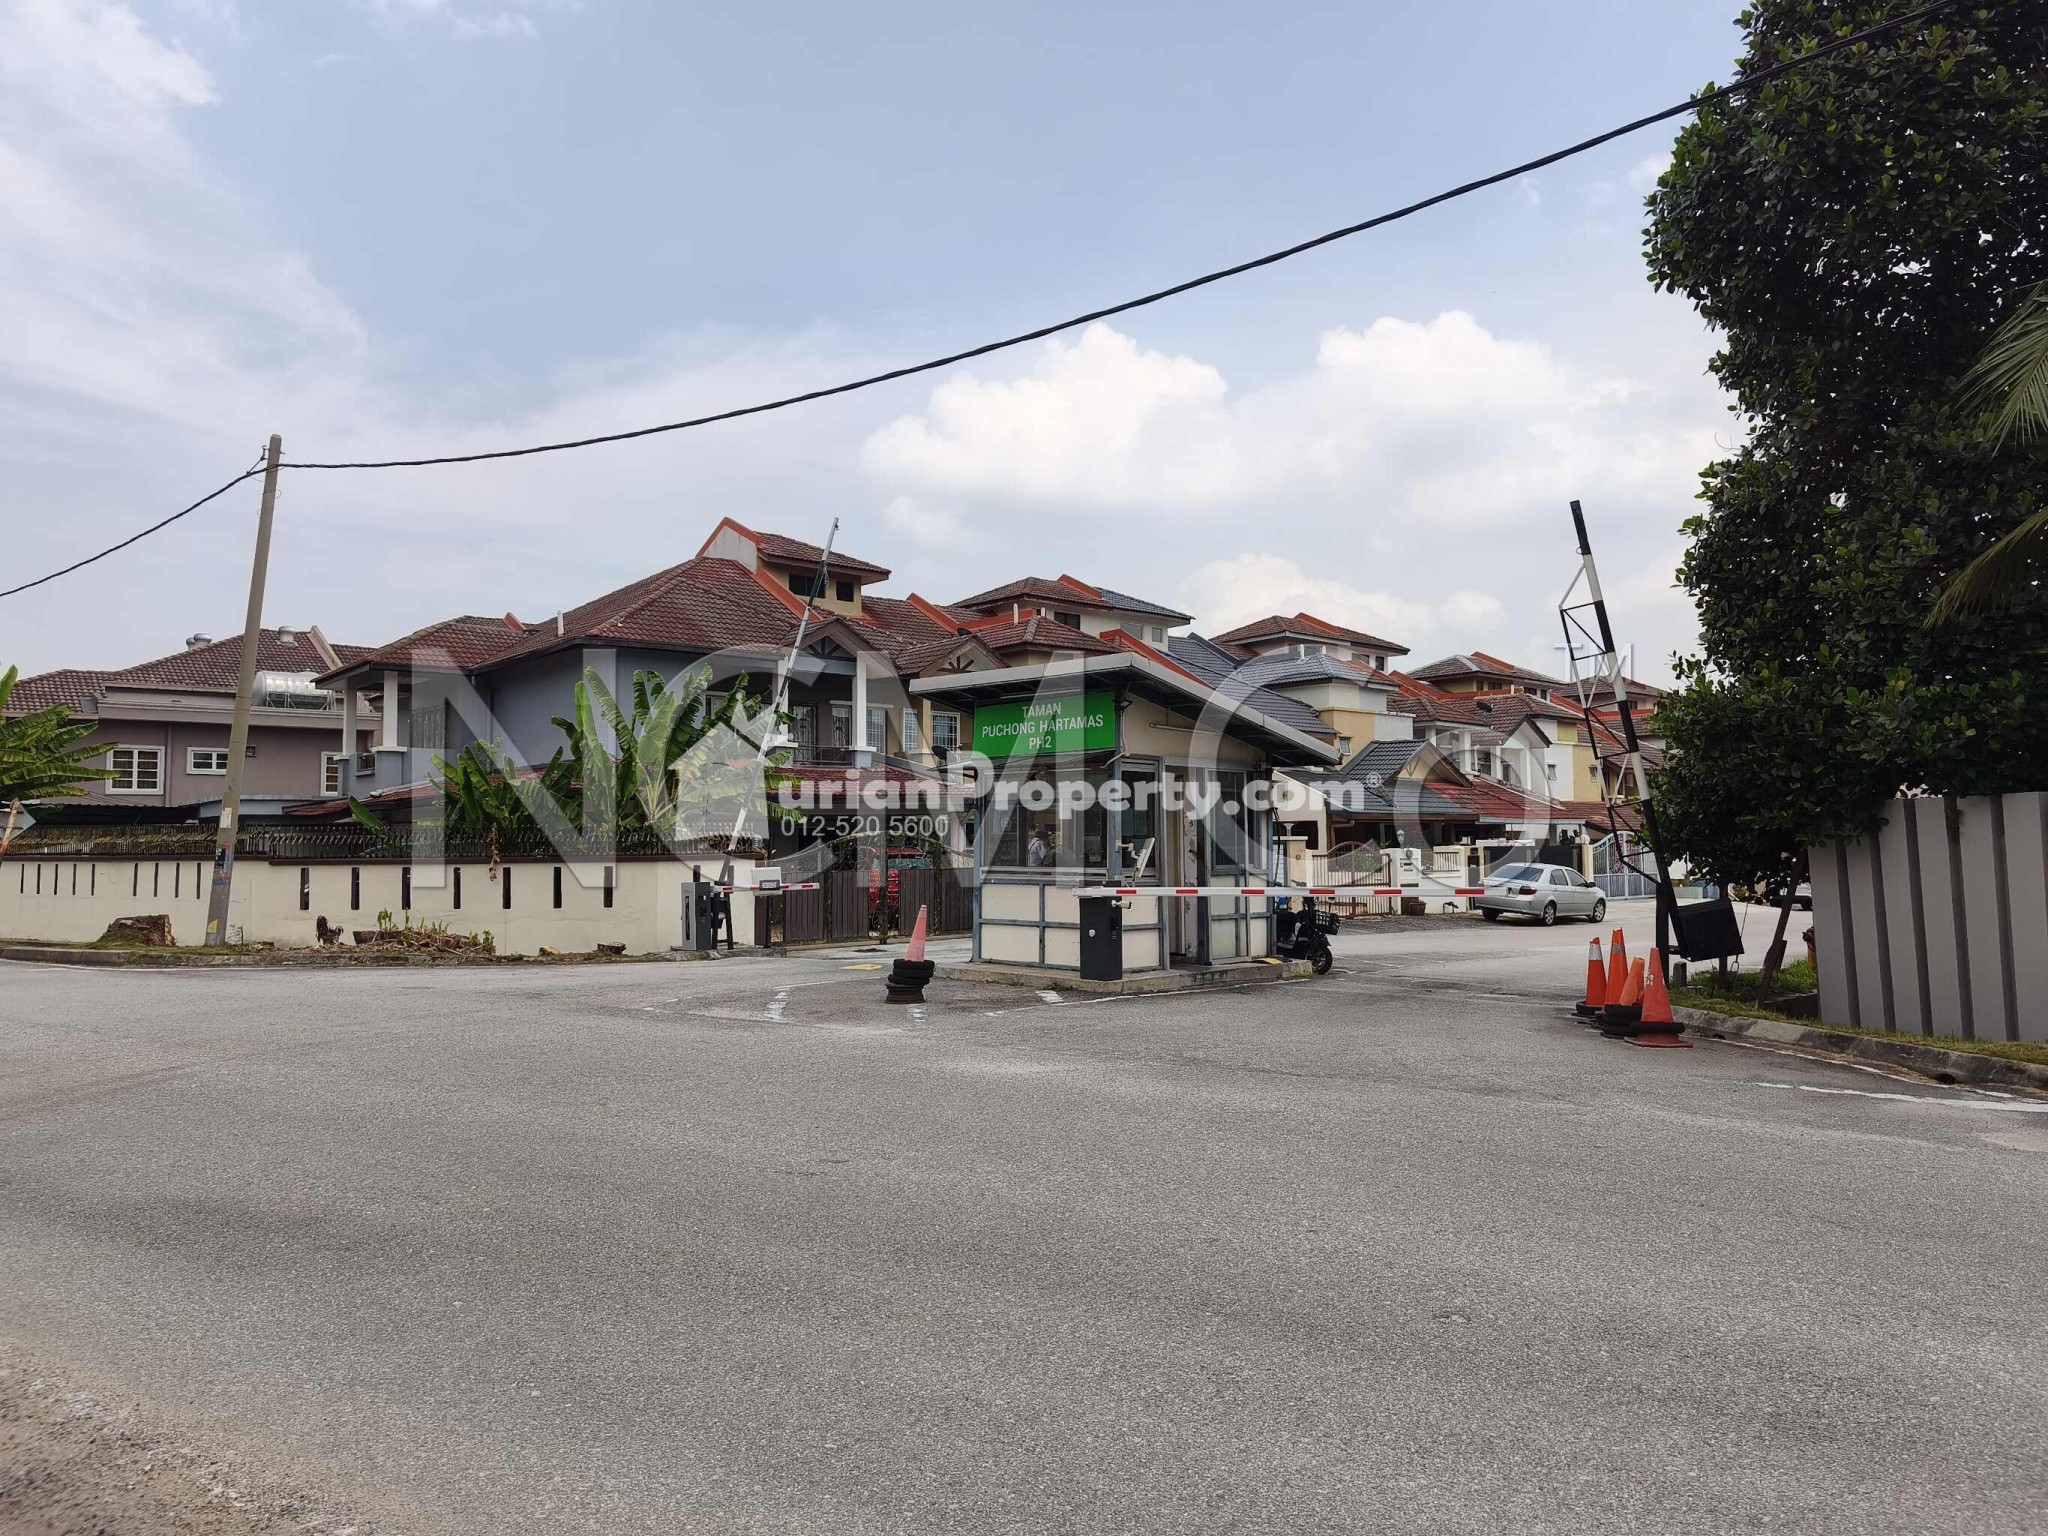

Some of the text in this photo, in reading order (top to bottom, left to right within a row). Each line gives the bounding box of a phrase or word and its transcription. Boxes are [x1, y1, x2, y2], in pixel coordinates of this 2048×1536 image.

[1022, 702, 1061, 718] TAMAN
[982, 714, 1104, 738] PUCHONG HARTAMAS
[1029, 736, 1052, 750] PH2
